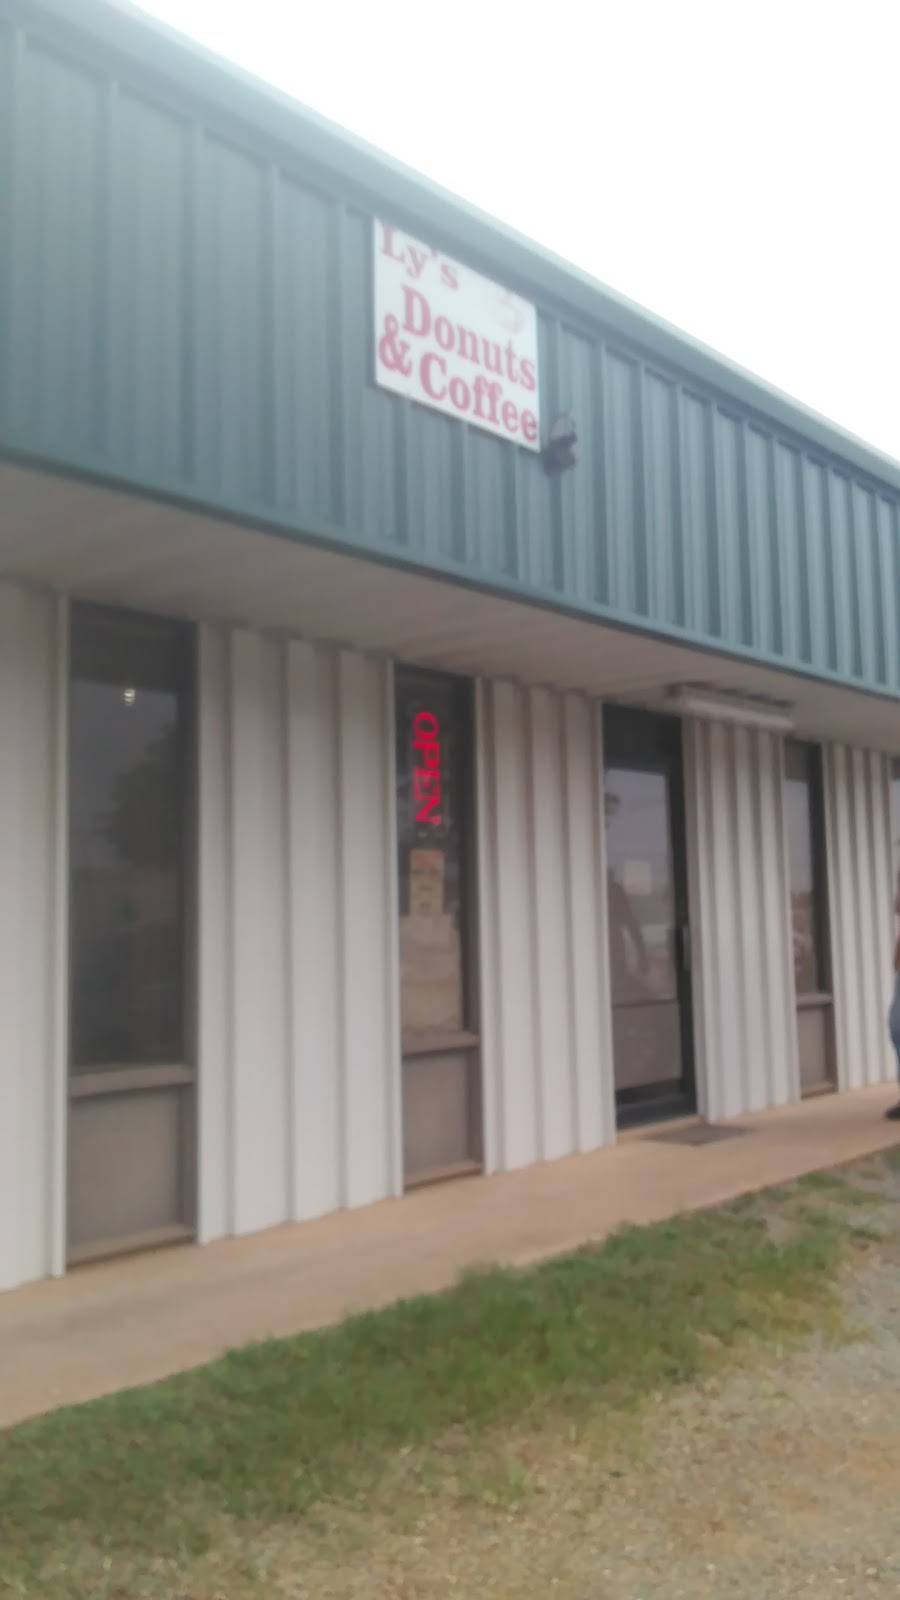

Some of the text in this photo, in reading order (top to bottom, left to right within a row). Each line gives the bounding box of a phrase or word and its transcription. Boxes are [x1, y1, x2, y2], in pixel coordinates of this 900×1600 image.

[382, 224, 458, 289] Ly's
[379, 313, 538, 442] & Coffee
[402, 284, 536, 392] Donuts
[412, 711, 441, 826] OPEN
